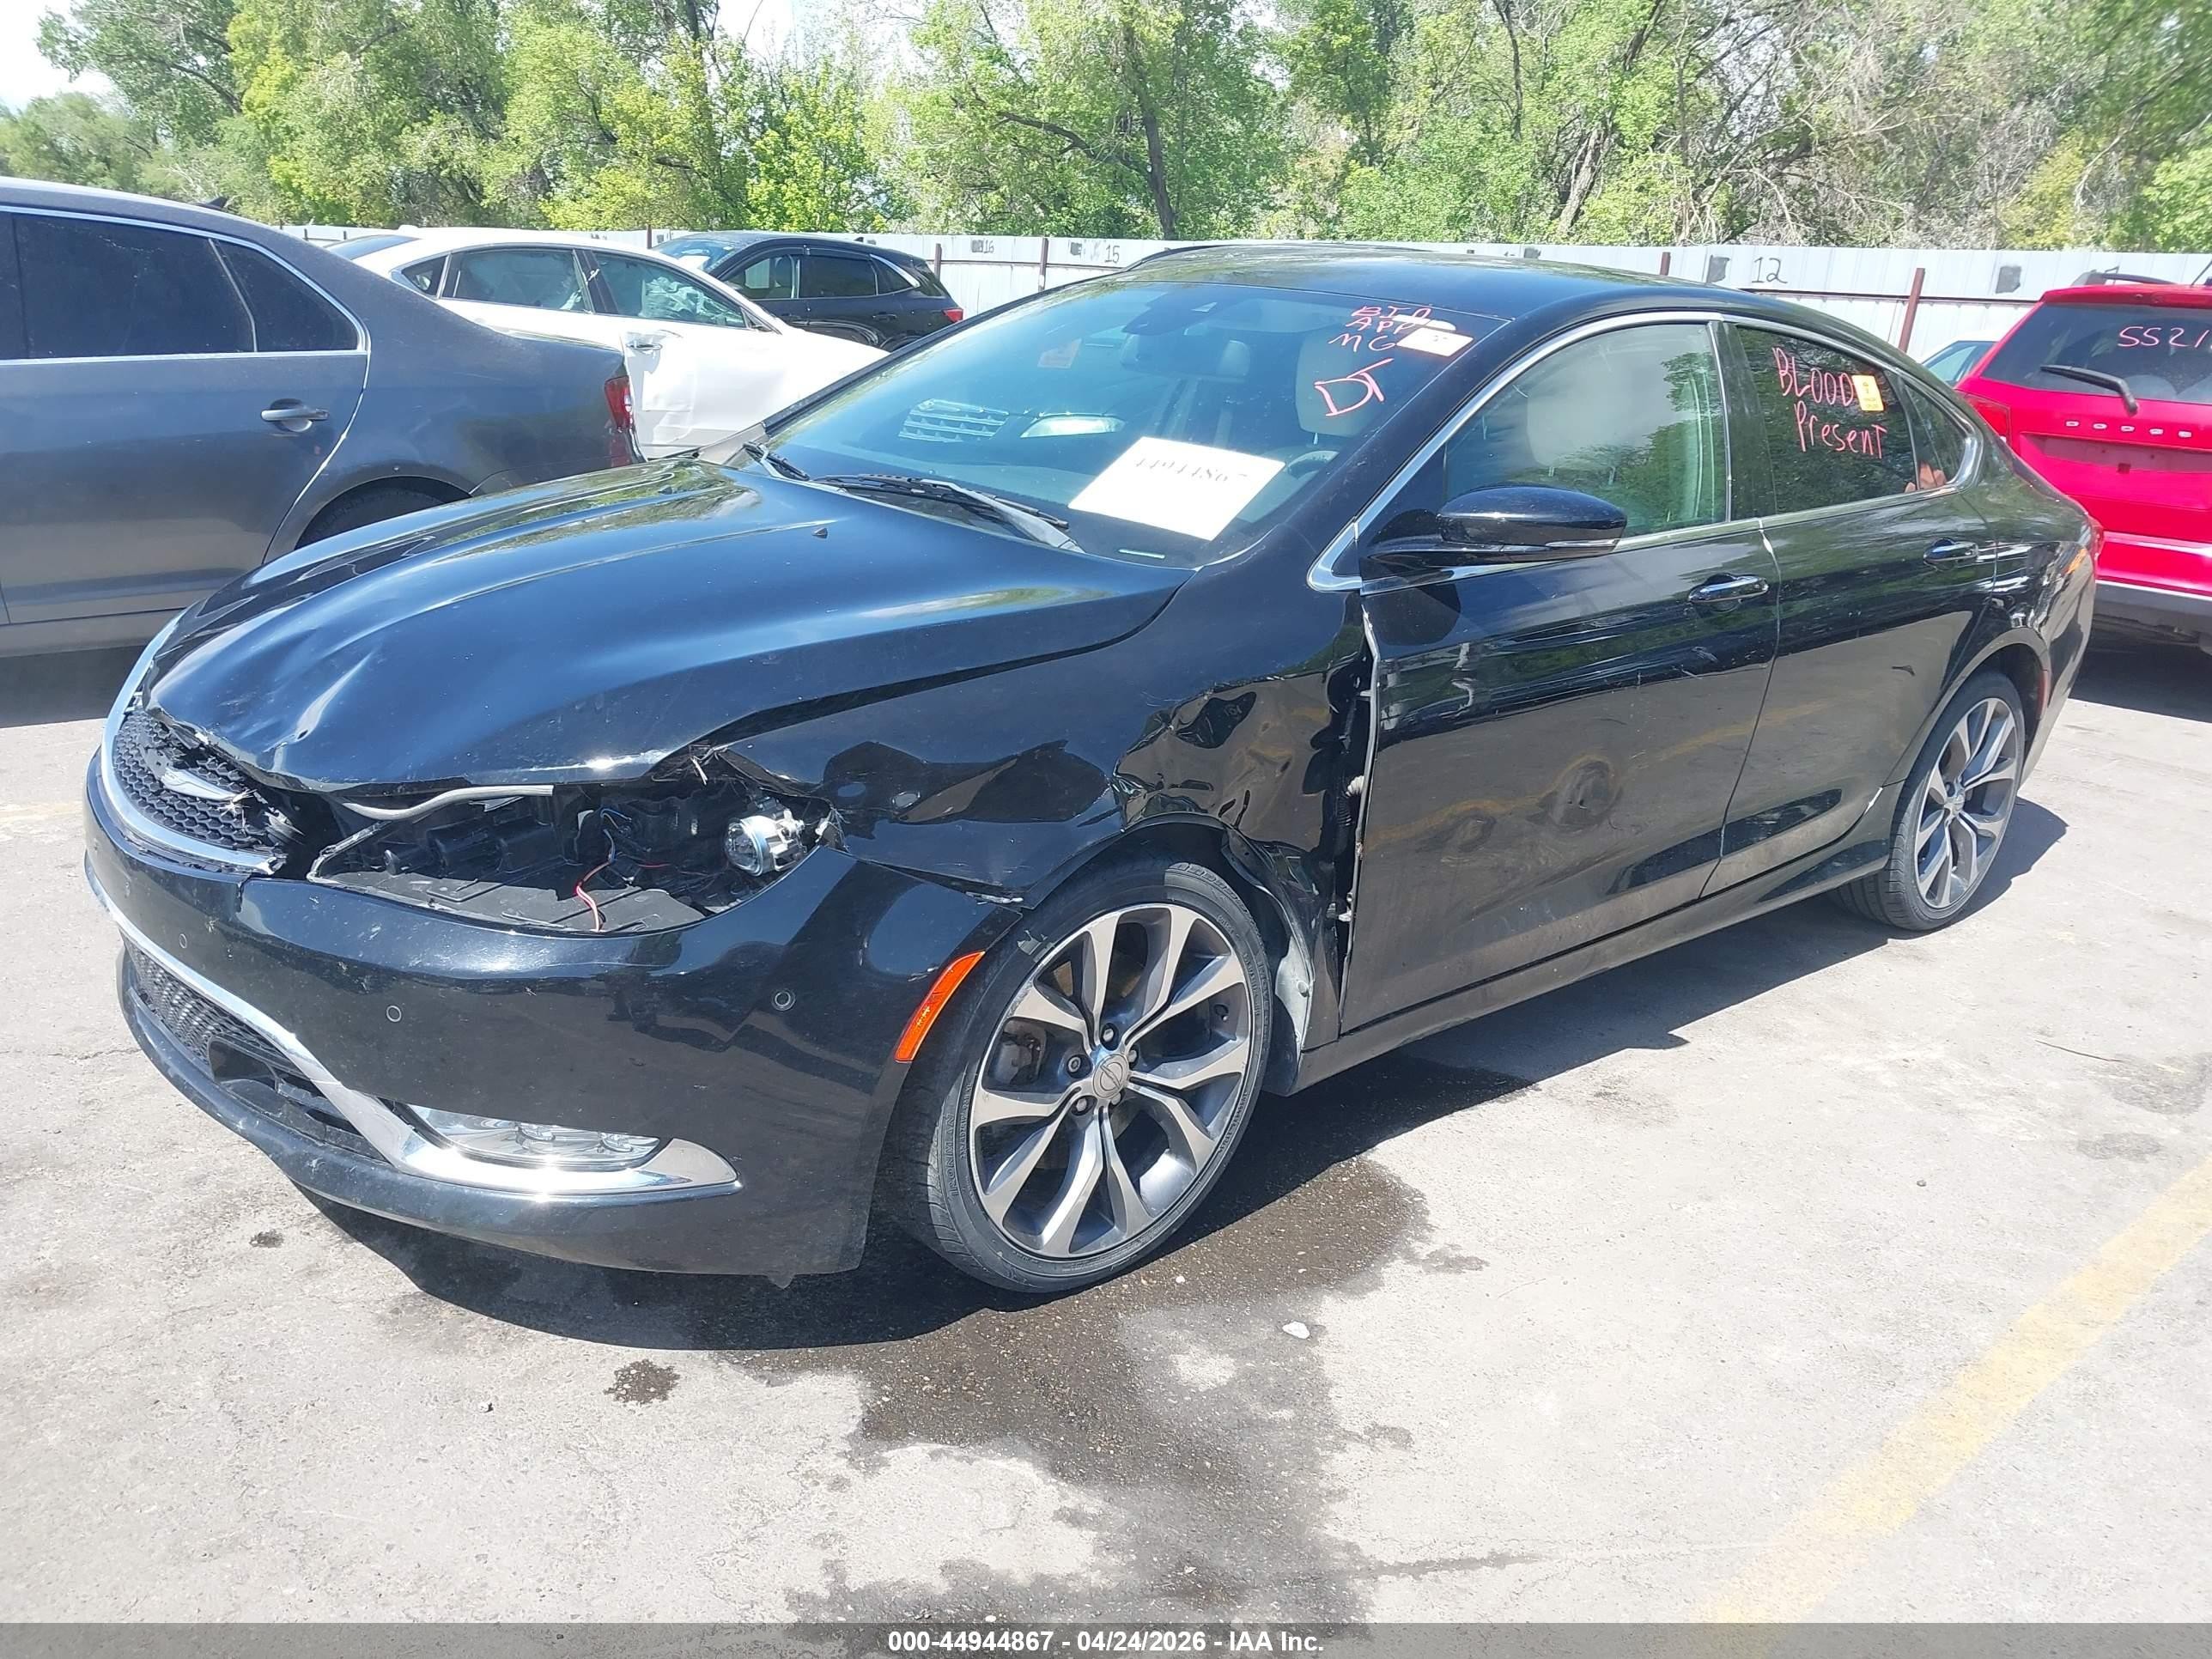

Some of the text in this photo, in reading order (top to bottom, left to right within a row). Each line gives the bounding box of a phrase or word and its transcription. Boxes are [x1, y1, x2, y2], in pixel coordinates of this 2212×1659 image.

[1104, 244, 1121, 264] 15
[1751, 257, 1788, 284] 12
[1771, 347, 1855, 407] BLOOD
